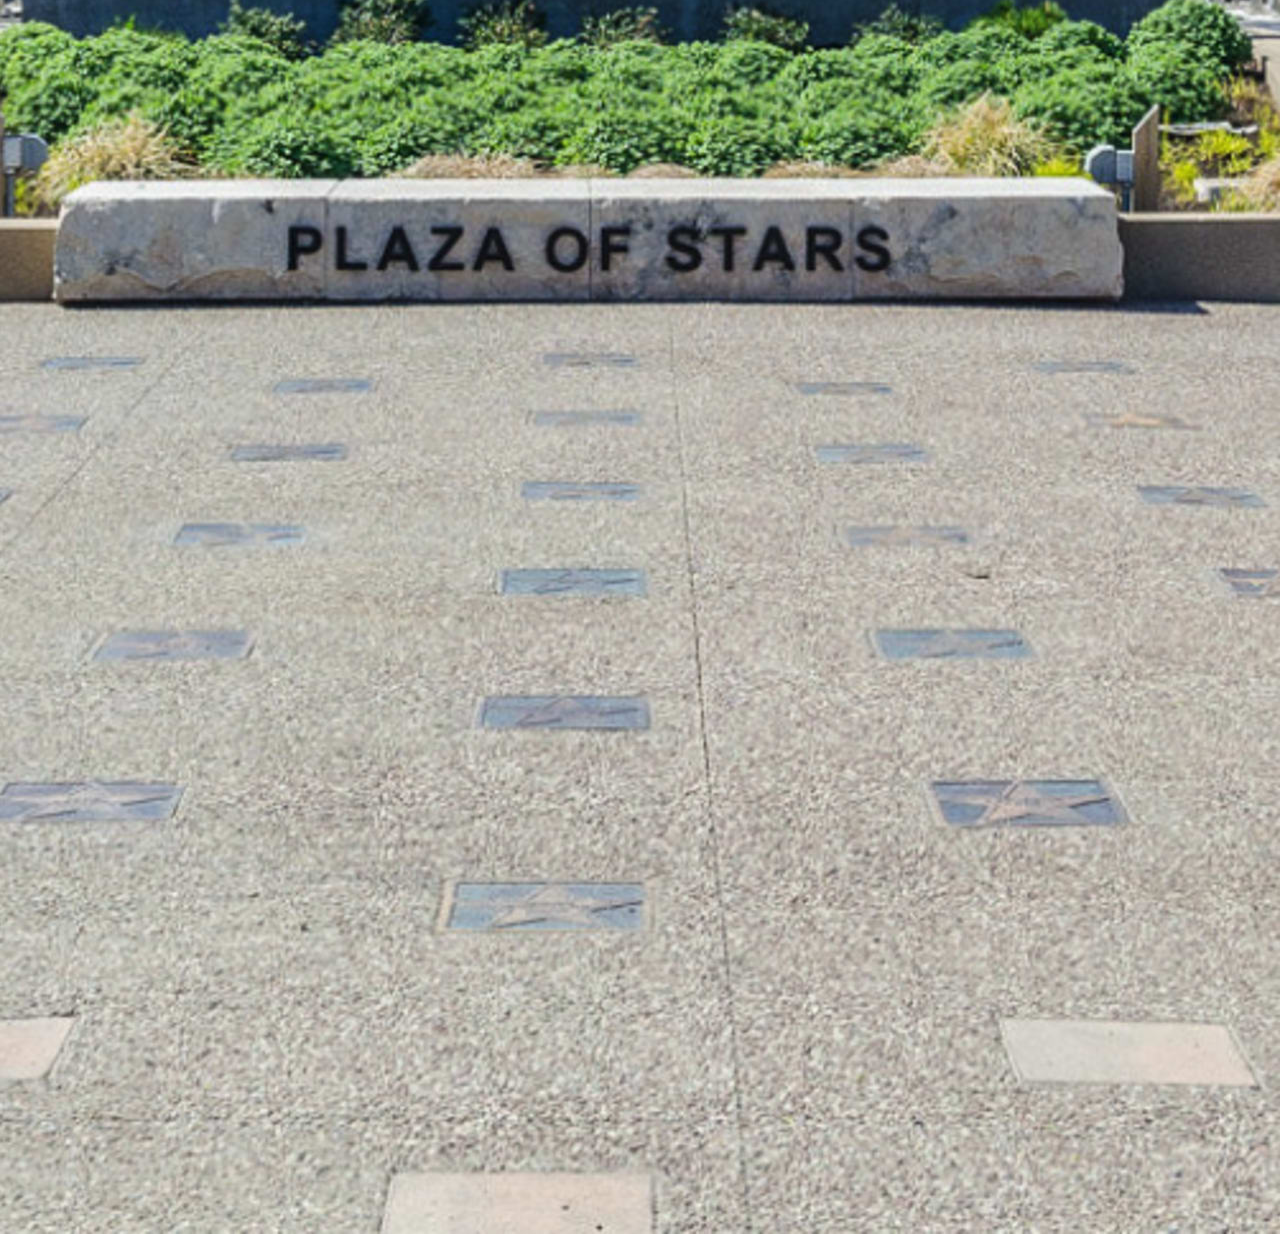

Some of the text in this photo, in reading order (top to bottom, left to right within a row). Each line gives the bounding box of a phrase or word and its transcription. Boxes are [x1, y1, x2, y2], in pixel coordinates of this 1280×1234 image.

[287, 225, 892, 273] PLAZA OF STARS
